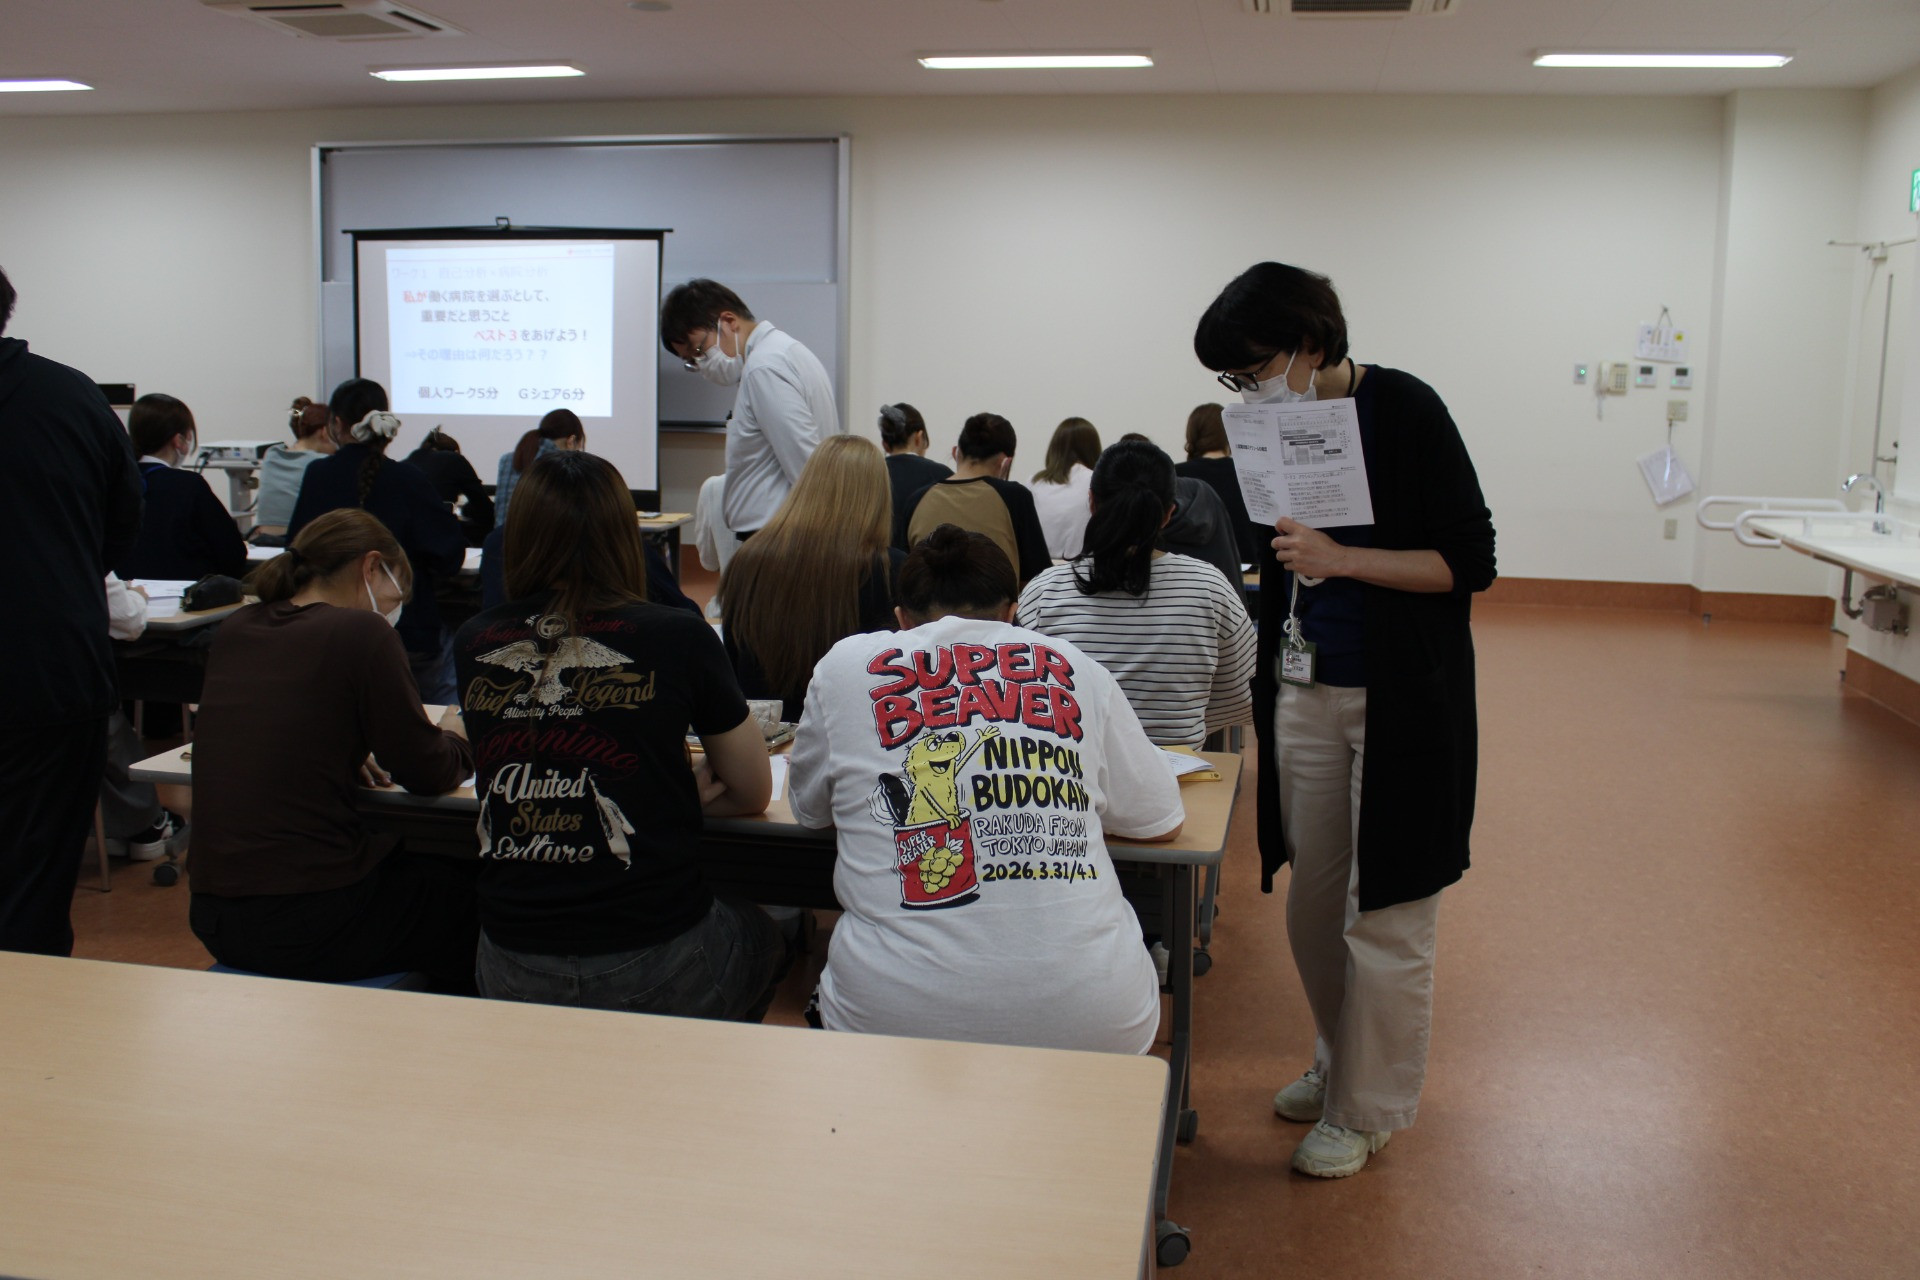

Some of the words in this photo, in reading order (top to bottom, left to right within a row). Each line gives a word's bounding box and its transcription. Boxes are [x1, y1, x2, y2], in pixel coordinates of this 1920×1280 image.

[403, 290, 550, 303] 私が働く病院を選ぶとして、
[421, 310, 510, 323] 重要だと思うこと
[418, 387, 498, 400] 個人ワーク5分
[518, 388, 585, 401] Gシェア6分
[866, 643, 1075, 701] SUPER
[464, 676, 527, 718] Chief
[564, 670, 656, 710] Legend
[502, 704, 545, 720] Minority
[548, 704, 583, 718] People
[872, 679, 1083, 750] BEAVER
[983, 736, 1083, 779] NIPPON
[493, 763, 590, 804] United
[971, 773, 1089, 812] BUDOKAN
[509, 800, 583, 838] States
[974, 813, 1045, 838] RAKUDA
[1048, 815, 1087, 838] FROM
[492, 834, 595, 864] Culture
[898, 829, 928, 852] SUPER
[900, 835, 937, 865] BEAVER
[981, 835, 1045, 857] TOKYO
[1047, 838, 1088, 858] JAPAN
[981, 861, 1098, 884] 2026.3.31/4.1
